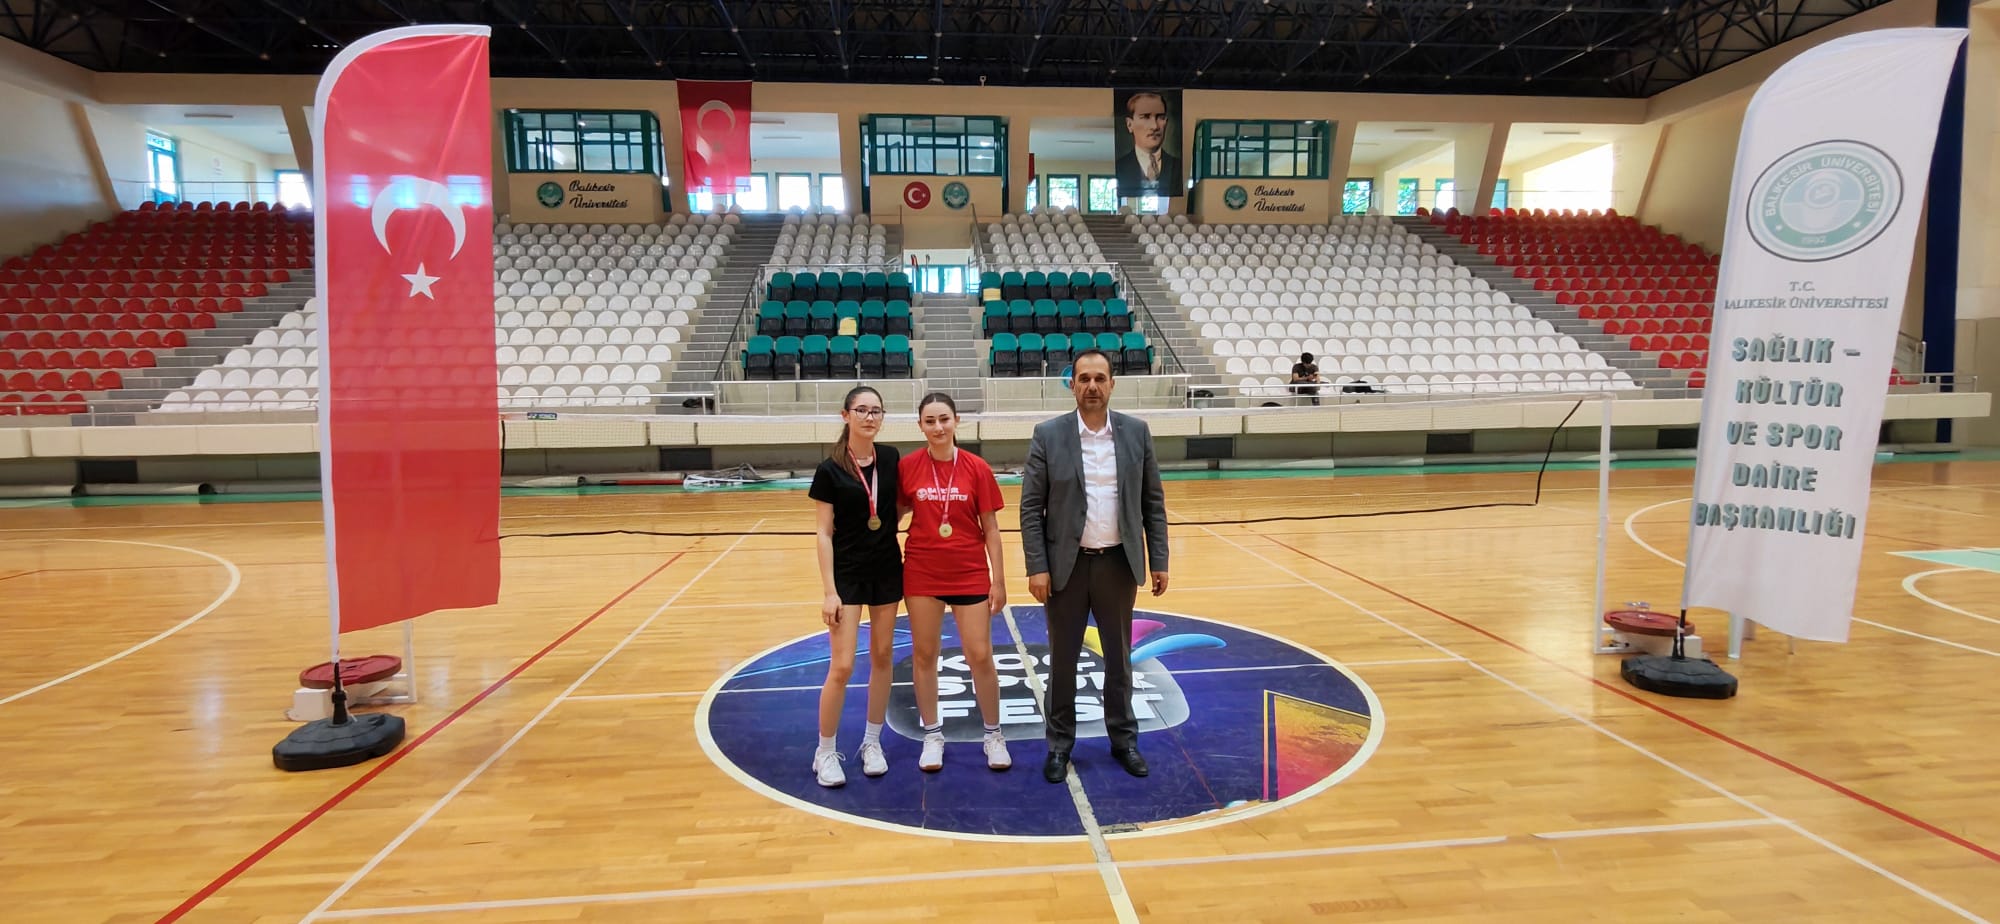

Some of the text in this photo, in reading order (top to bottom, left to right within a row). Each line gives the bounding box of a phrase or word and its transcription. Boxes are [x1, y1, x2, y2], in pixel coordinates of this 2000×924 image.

[1789, 281, 1815, 292] T.C.
[1789, 296, 1889, 309] ÜNİVERSİTESİ
[1732, 333, 1835, 363] SAĞLIK
[1735, 376, 1844, 407] KÜLTÜR
[1726, 421, 1843, 451] VE SPOR
[1732, 460, 1818, 491] DAİRE
[1695, 502, 1856, 539] BAŞKANLIĞI
